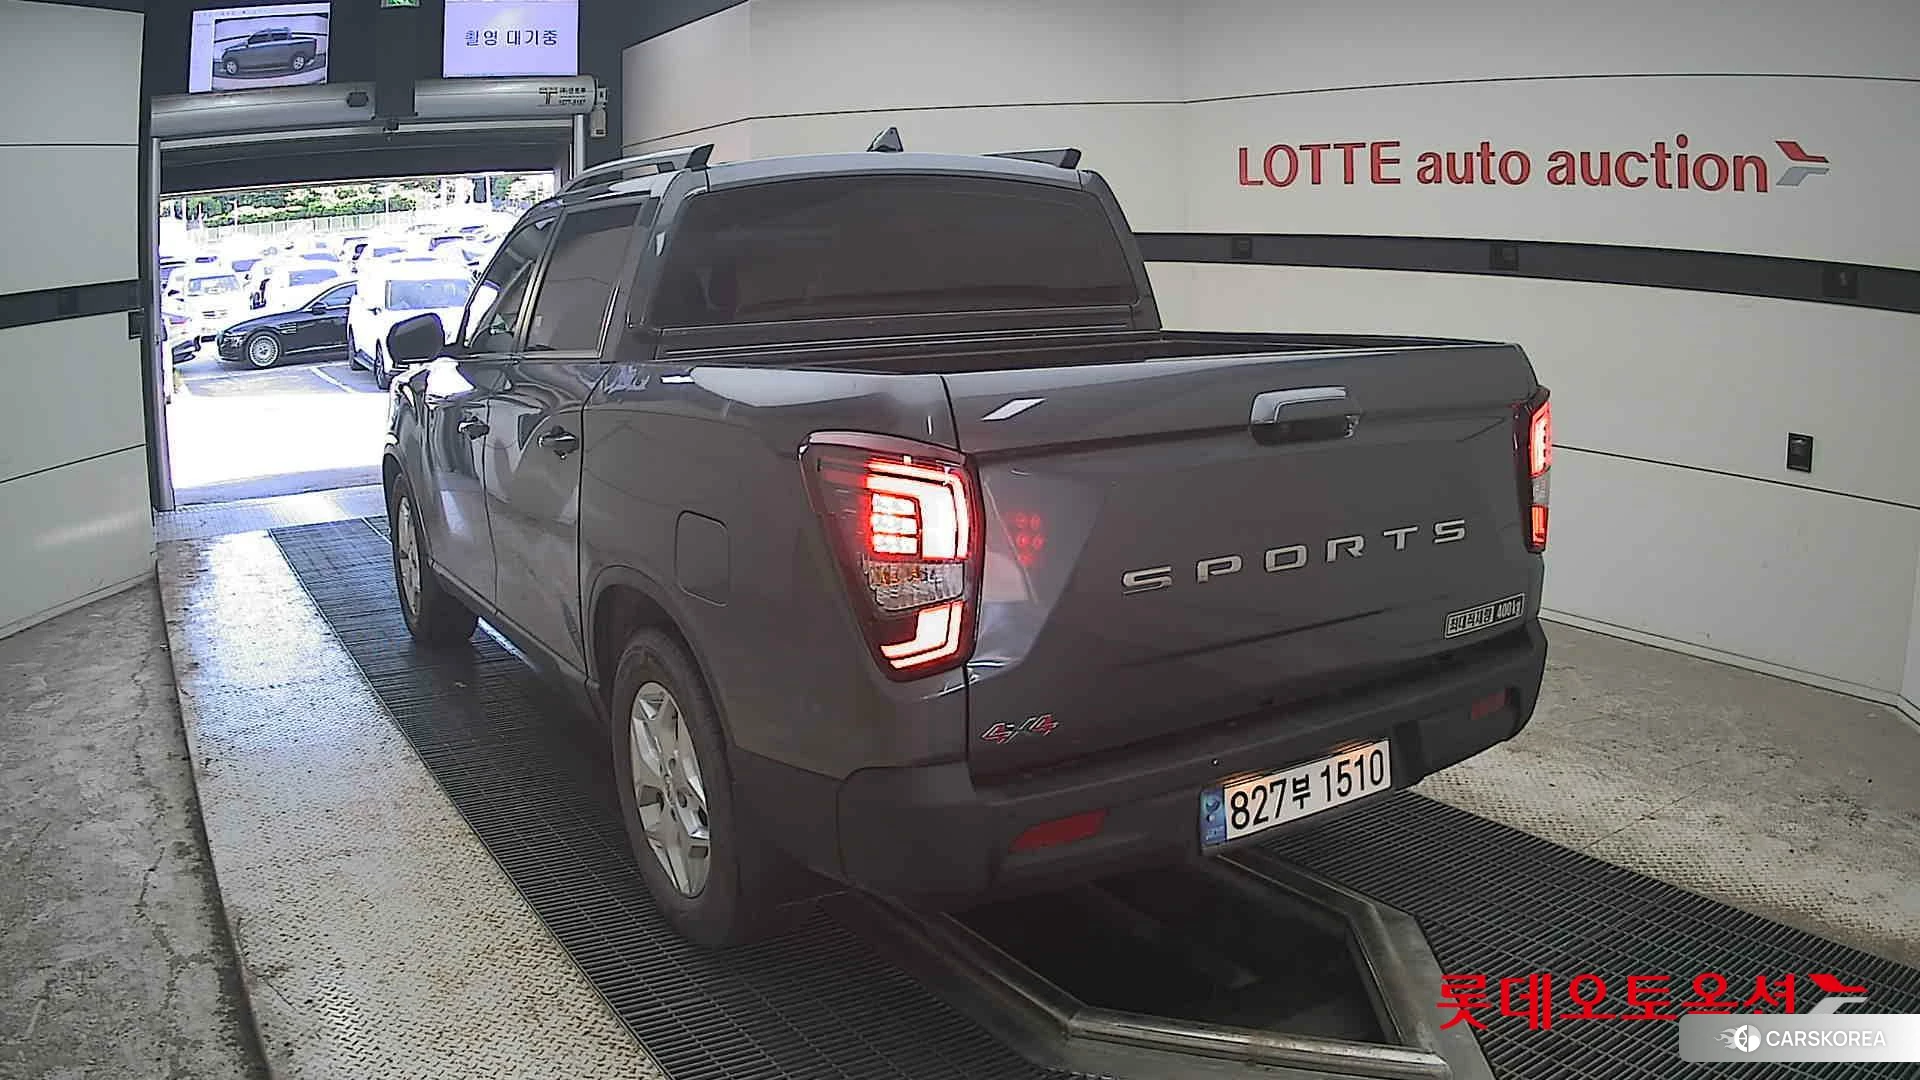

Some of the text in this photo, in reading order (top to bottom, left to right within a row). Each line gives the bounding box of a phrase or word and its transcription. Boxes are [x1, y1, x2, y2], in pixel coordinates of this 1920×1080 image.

[506, 30, 558, 46] 대기중
[1239, 133, 1769, 193] LOTTE auto auction
[1122, 519, 1466, 595] SPORTS
[1230, 749, 1385, 830] 827부 1510
